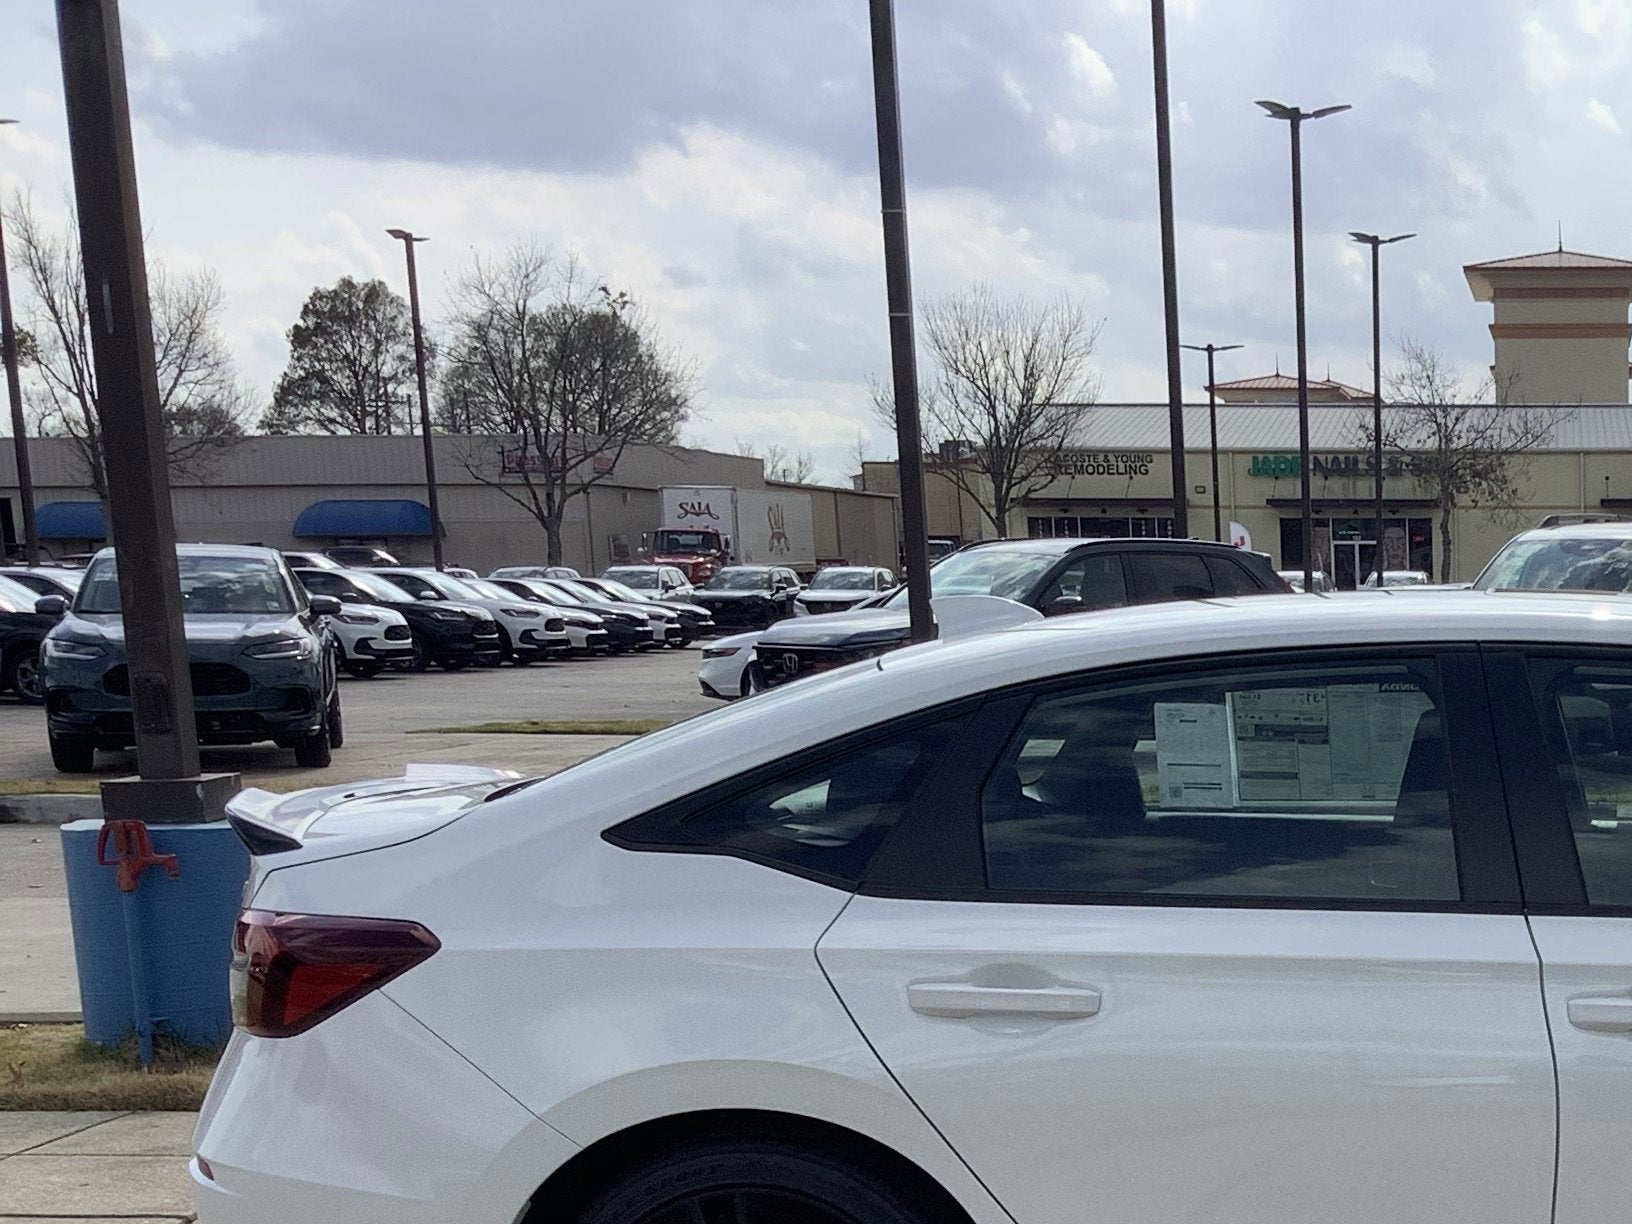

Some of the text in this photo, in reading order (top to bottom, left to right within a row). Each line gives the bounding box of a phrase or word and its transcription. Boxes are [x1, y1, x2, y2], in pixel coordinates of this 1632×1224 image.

[1113, 454, 1153, 464] YOUNG
[1055, 464, 1149, 476] REMODELING
[677, 501, 719, 520] SAIA
